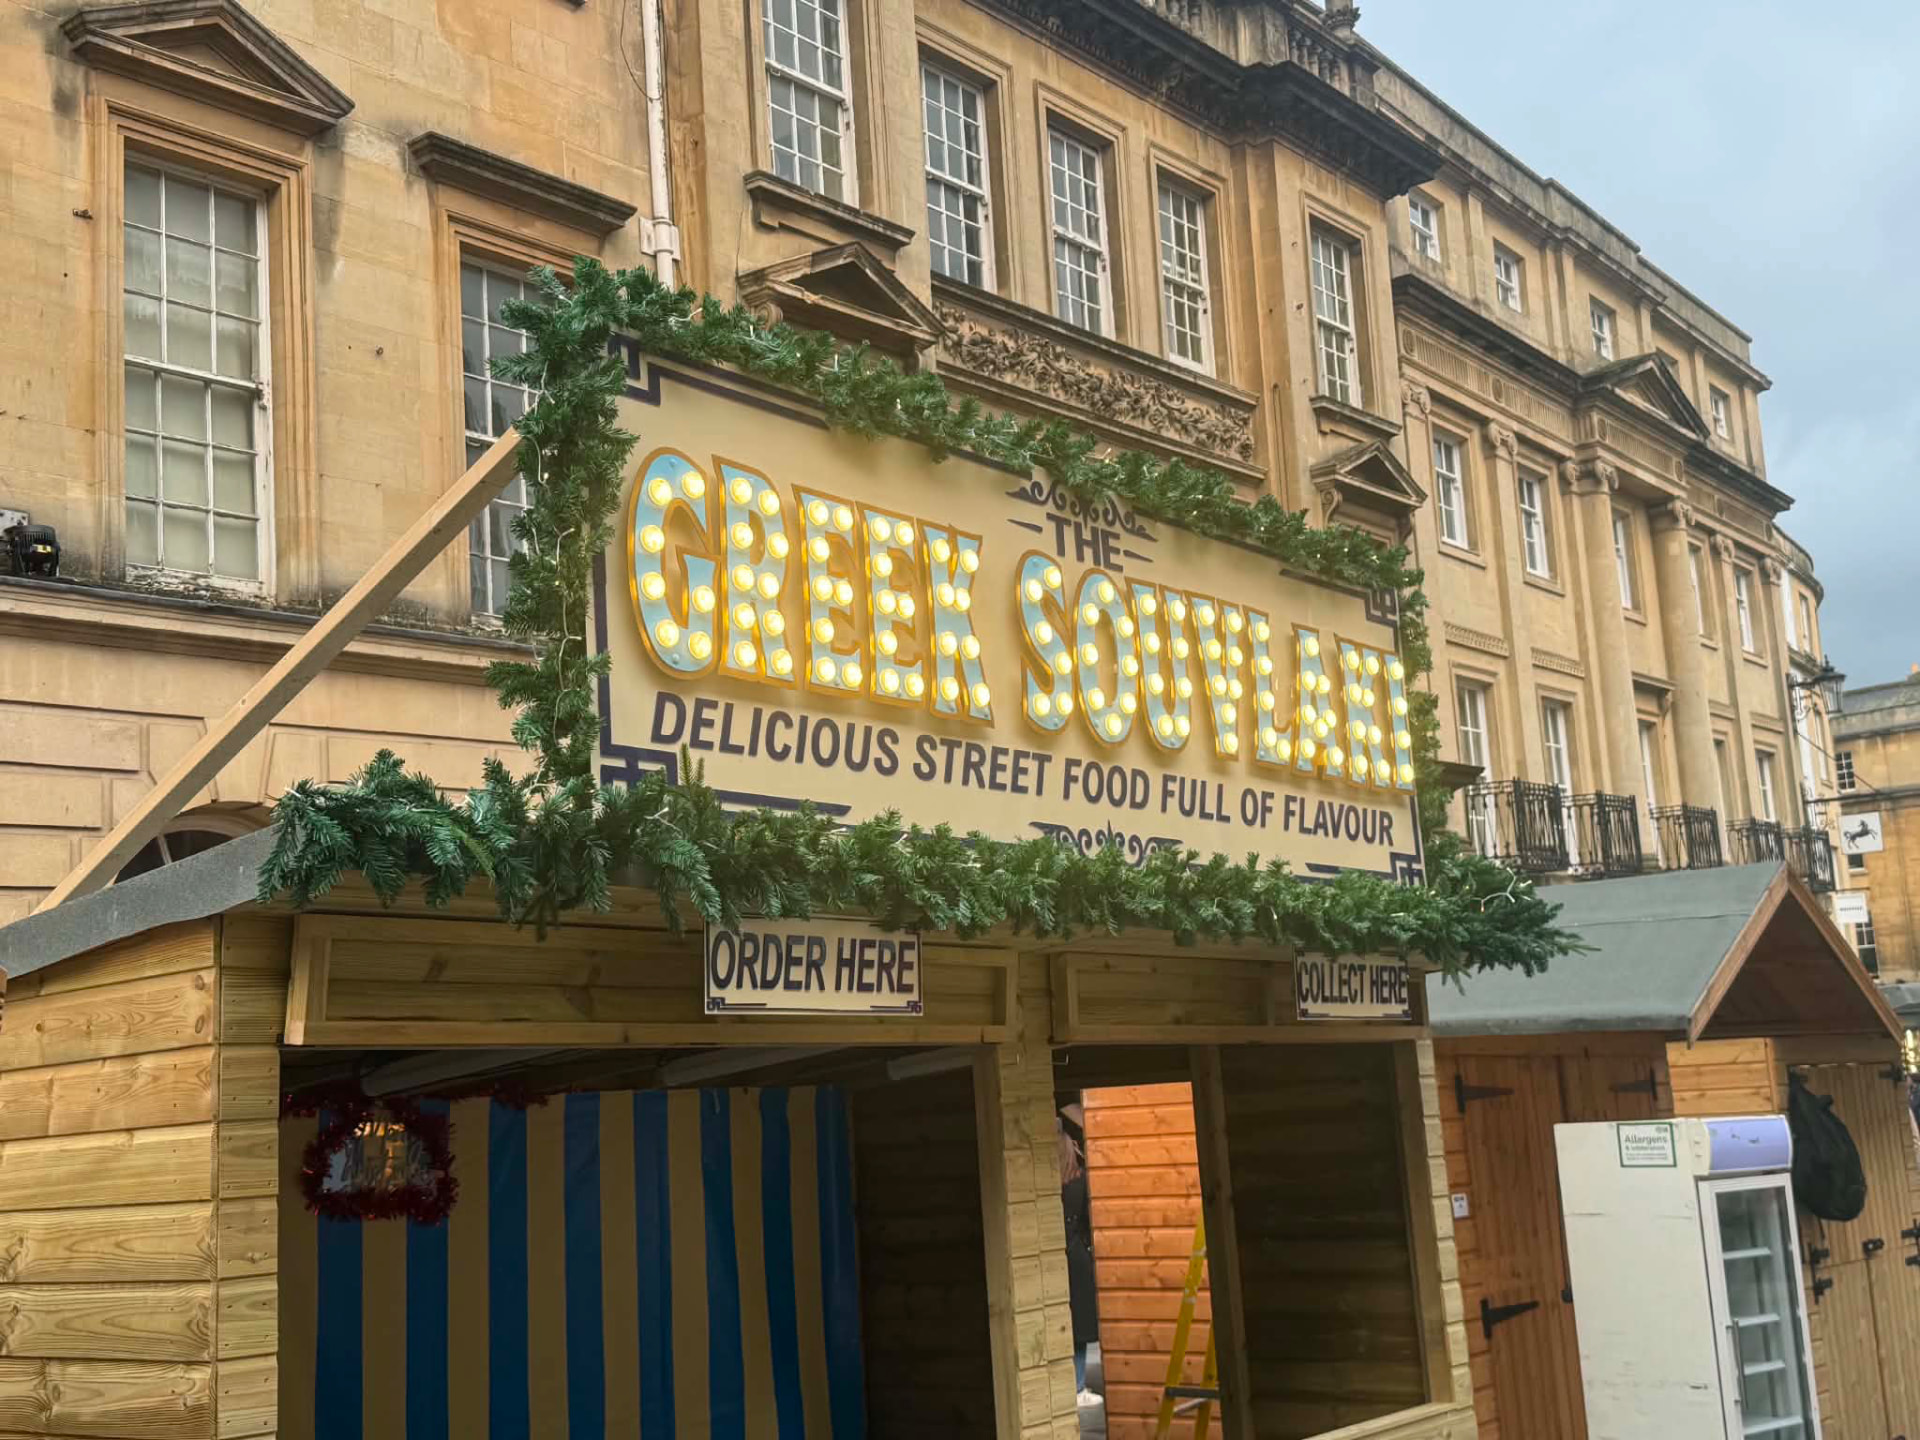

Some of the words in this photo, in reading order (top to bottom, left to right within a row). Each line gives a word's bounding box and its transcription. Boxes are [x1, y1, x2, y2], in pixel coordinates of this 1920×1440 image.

[1046, 512, 1123, 573] THE
[627, 447, 994, 728] GREEK
[1015, 549, 1417, 796] SOUVLAKI
[651, 691, 899, 776] DELICIOUS
[913, 735, 1052, 796] STREET
[1063, 758, 1150, 810] FOOD
[1161, 774, 1231, 824] FULL
[1241, 788, 1275, 828] OF
[1284, 794, 1394, 847] FLAVOUR
[711, 930, 826, 991] ORDER
[835, 937, 916, 993] HERE
[1299, 961, 1366, 1004] COLLECT
[1370, 965, 1408, 1004] HERE
